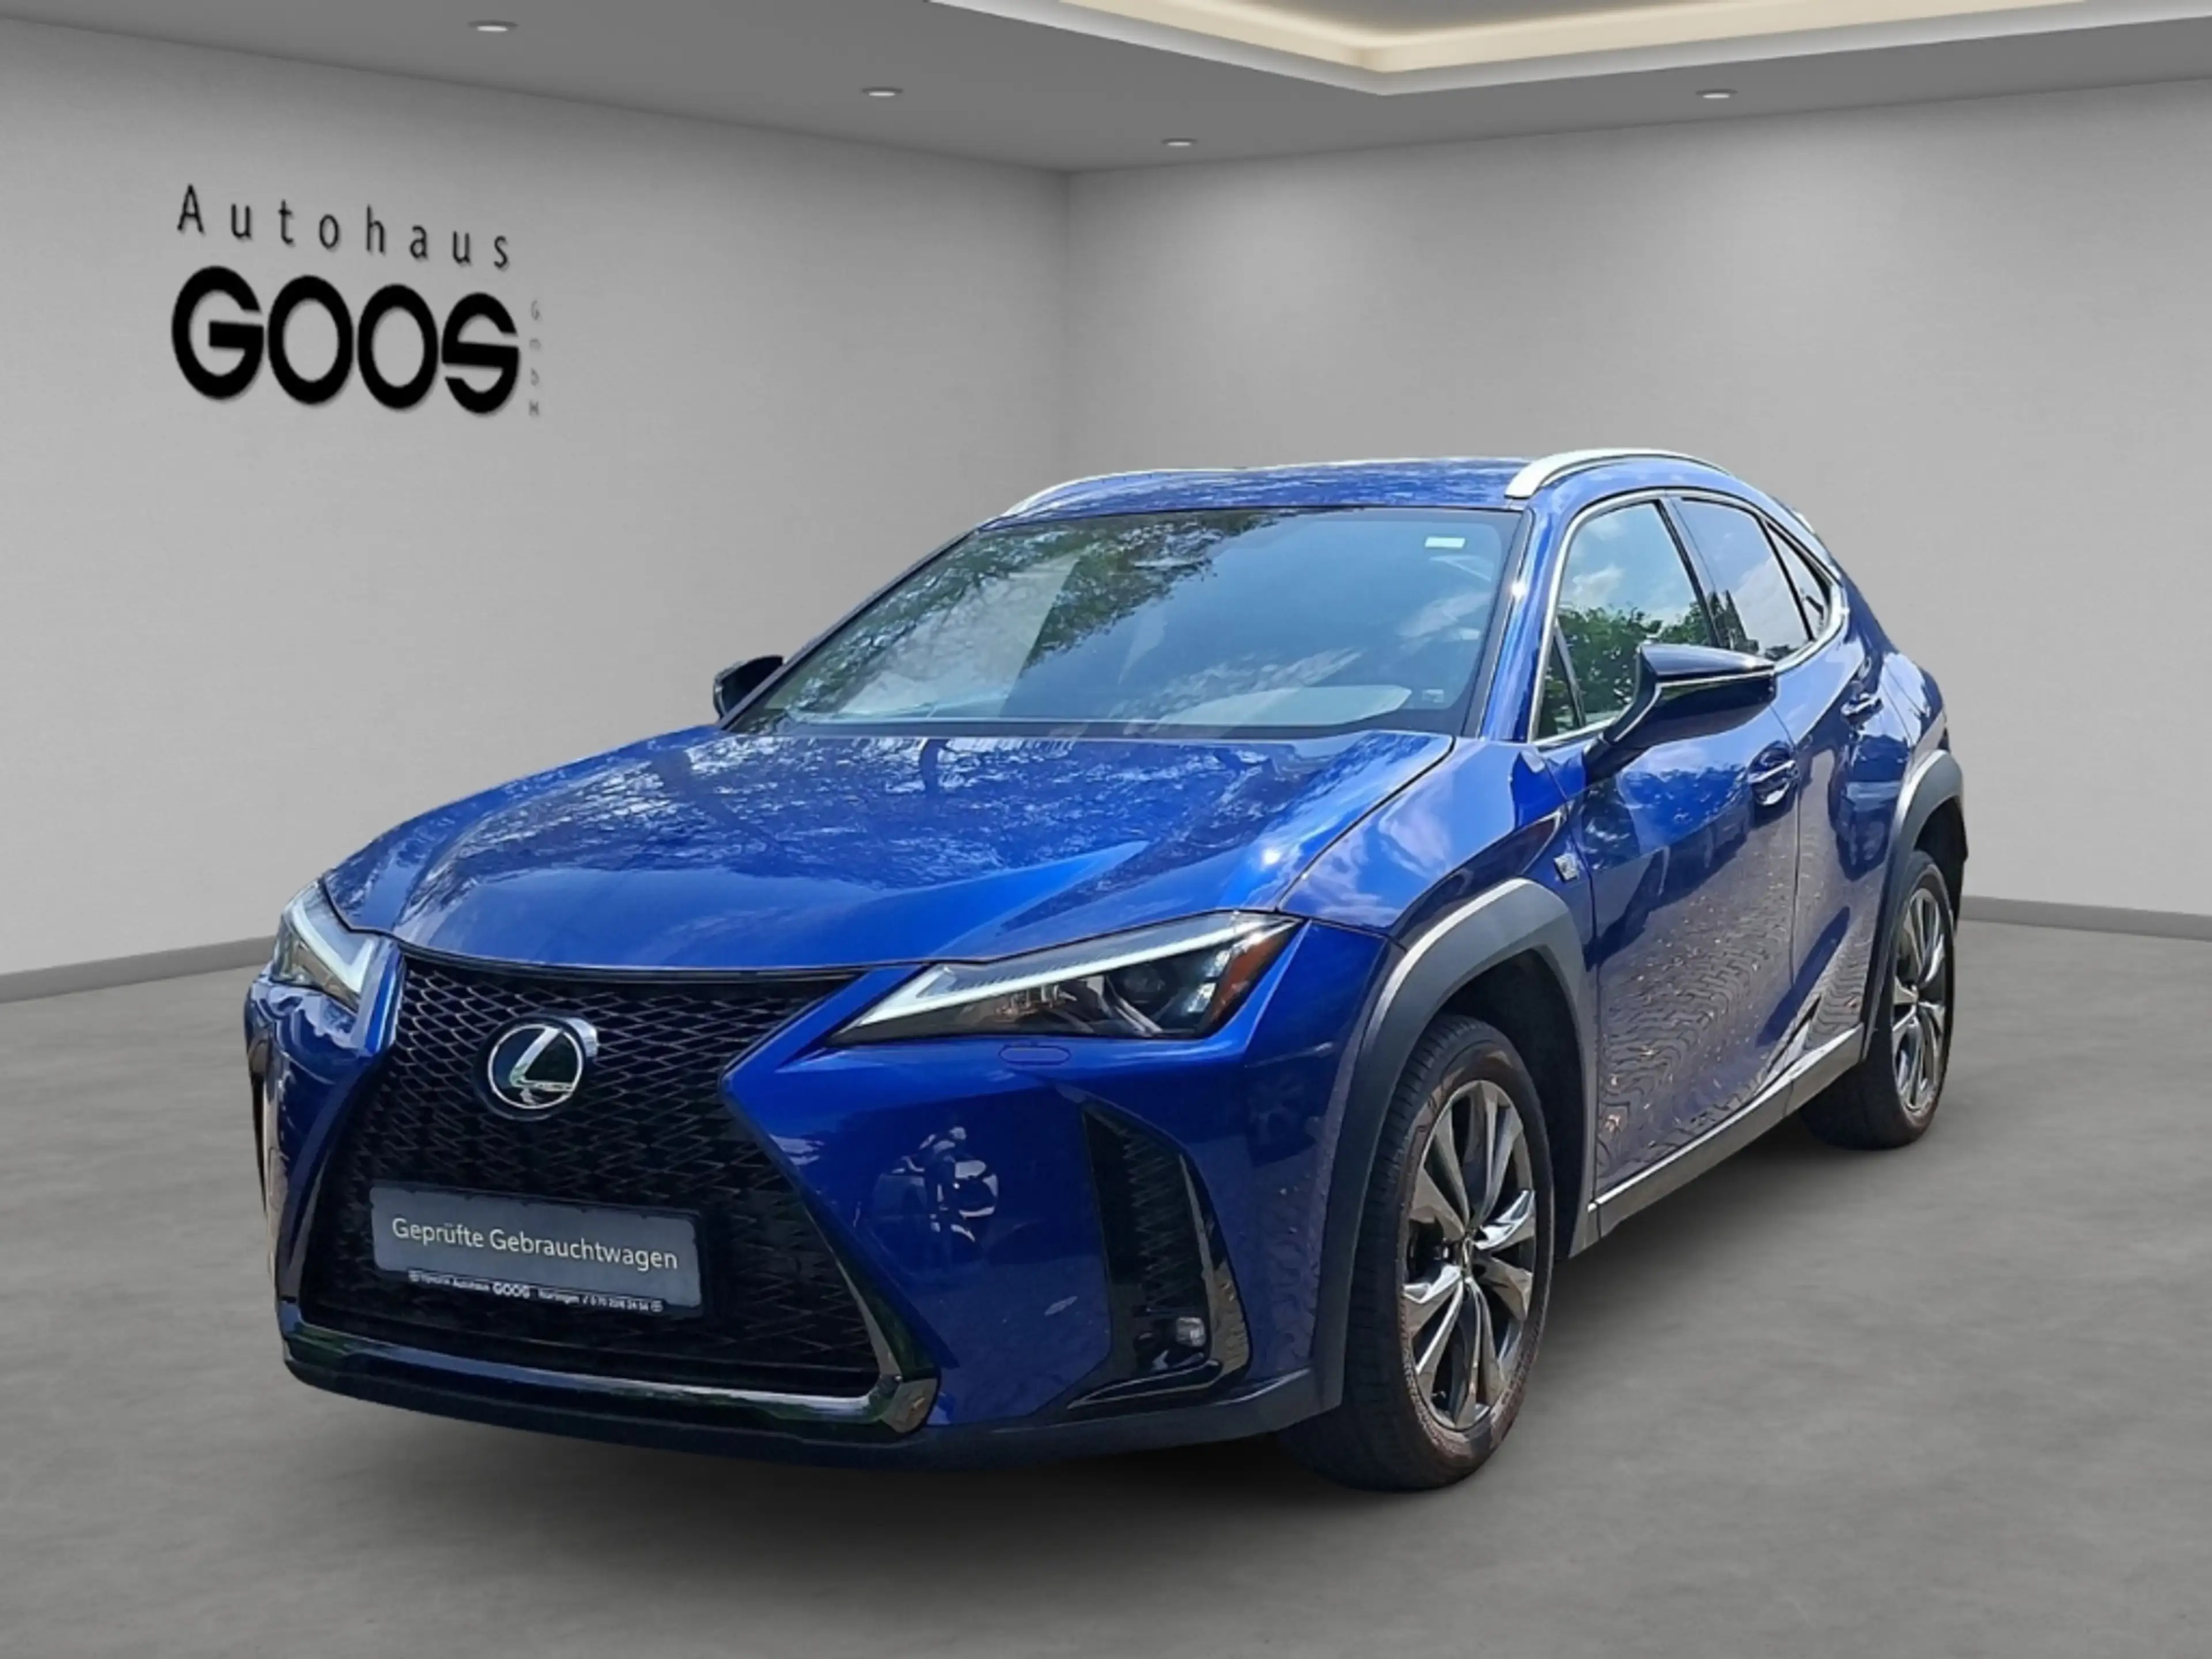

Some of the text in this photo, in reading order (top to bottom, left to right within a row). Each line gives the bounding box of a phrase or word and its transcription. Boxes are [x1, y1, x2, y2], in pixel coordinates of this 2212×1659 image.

[177, 184, 510, 269] Autohaus
[171, 265, 520, 415] GOOS
[392, 1217, 677, 1271] Geprüfte Gebrauchtwagen
